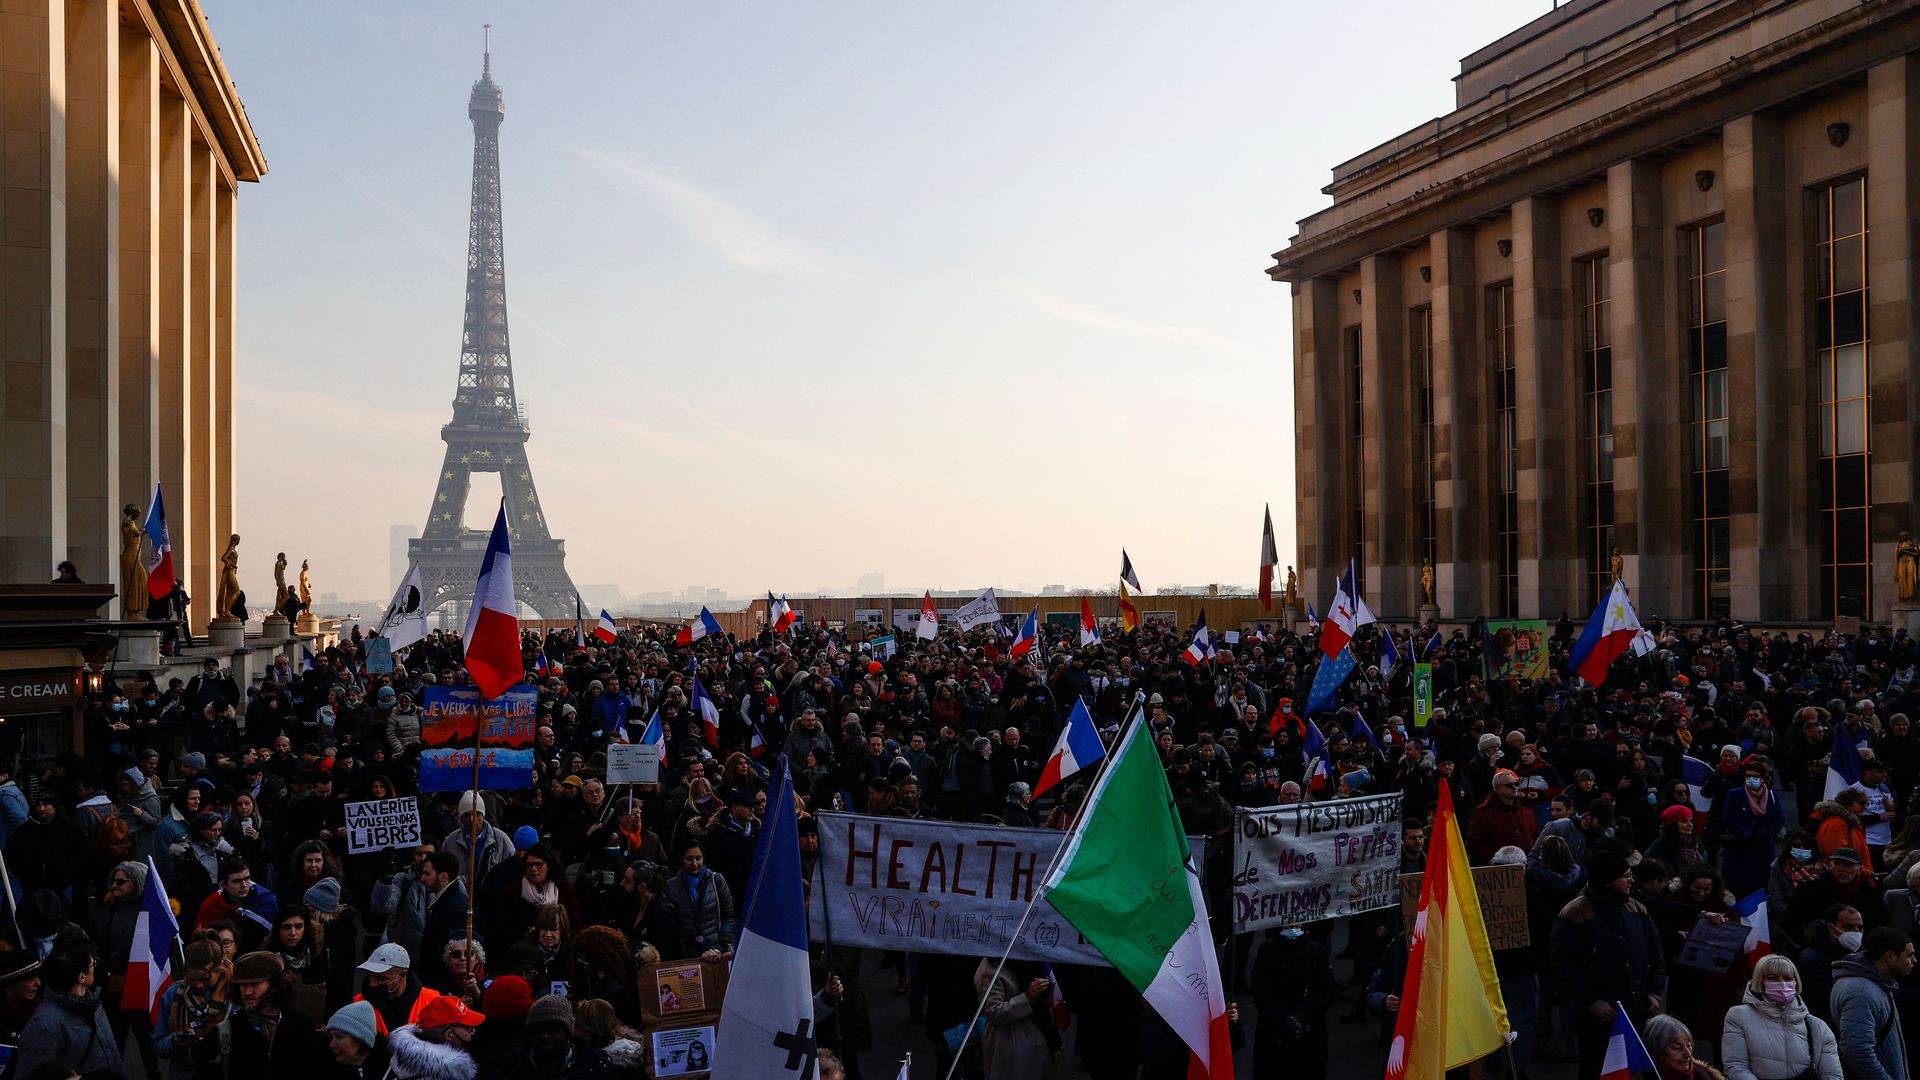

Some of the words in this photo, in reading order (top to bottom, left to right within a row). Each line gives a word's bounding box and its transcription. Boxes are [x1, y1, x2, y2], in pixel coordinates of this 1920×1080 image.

[11, 683, 68, 697] CREAM
[427, 702, 439, 717] JE
[441, 702, 471, 716] VEUX
[504, 701, 536, 718] LIBRE
[347, 816, 381, 830] VOUS
[845, 821, 1037, 903] HEALTH
[1232, 850, 1260, 887] de
[1474, 868, 1521, 892] ANNIE
[1232, 883, 1332, 924] DÉFENDONS
[1480, 890, 1505, 909] ALE
